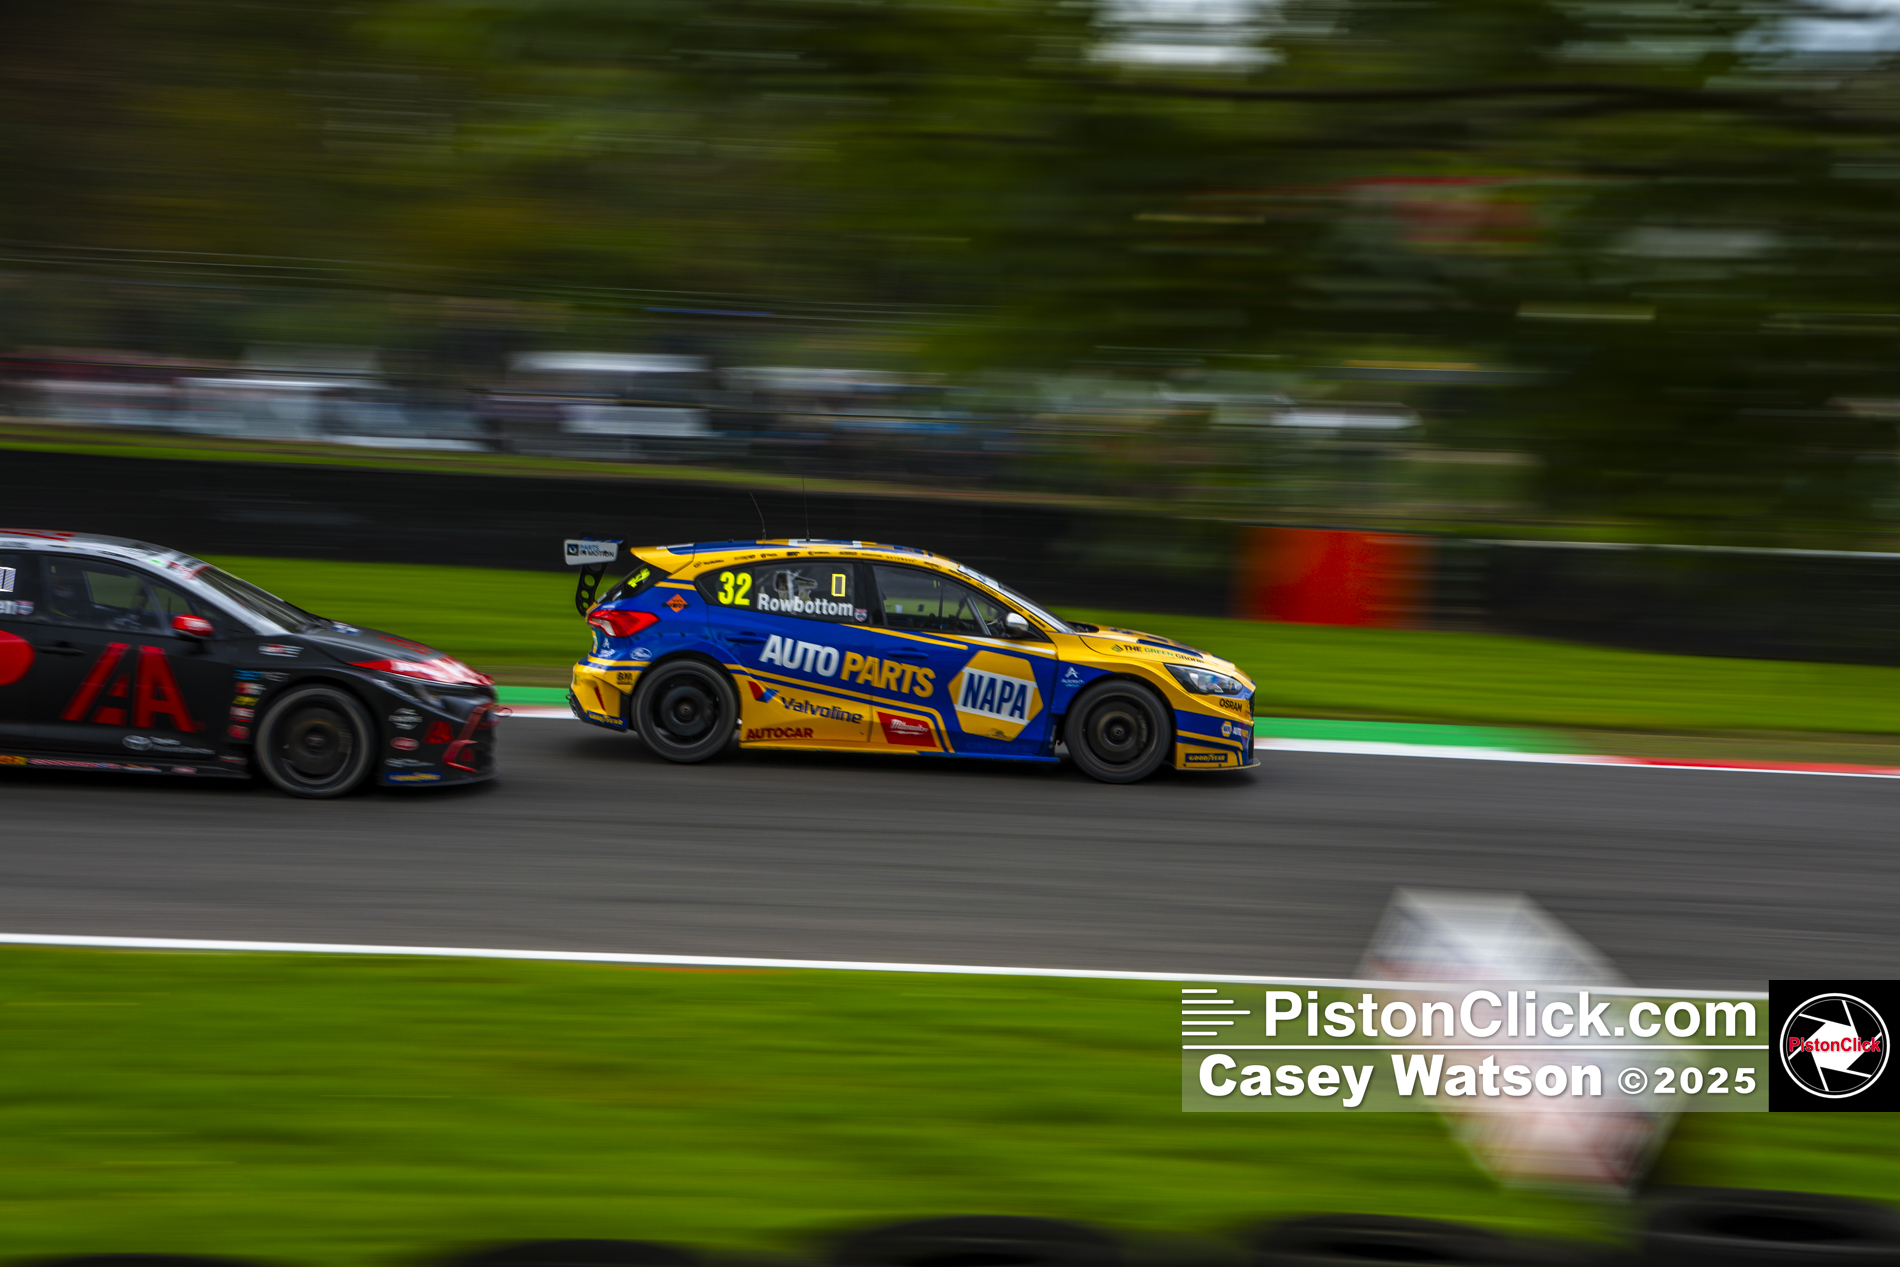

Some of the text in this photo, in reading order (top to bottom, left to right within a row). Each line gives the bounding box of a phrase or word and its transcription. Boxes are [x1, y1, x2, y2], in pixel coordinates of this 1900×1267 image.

[717, 571, 752, 606] 32
[757, 592, 854, 617] Rowbottom
[1123, 644, 1142, 652] THE
[1143, 645, 1174, 657] GREEN
[759, 634, 936, 698] AUTO PARTS
[962, 672, 1027, 721] NAPA
[1219, 698, 1243, 713] OSRAM
[781, 696, 864, 725] Valvoline
[746, 727, 814, 741] AUTOCAR
